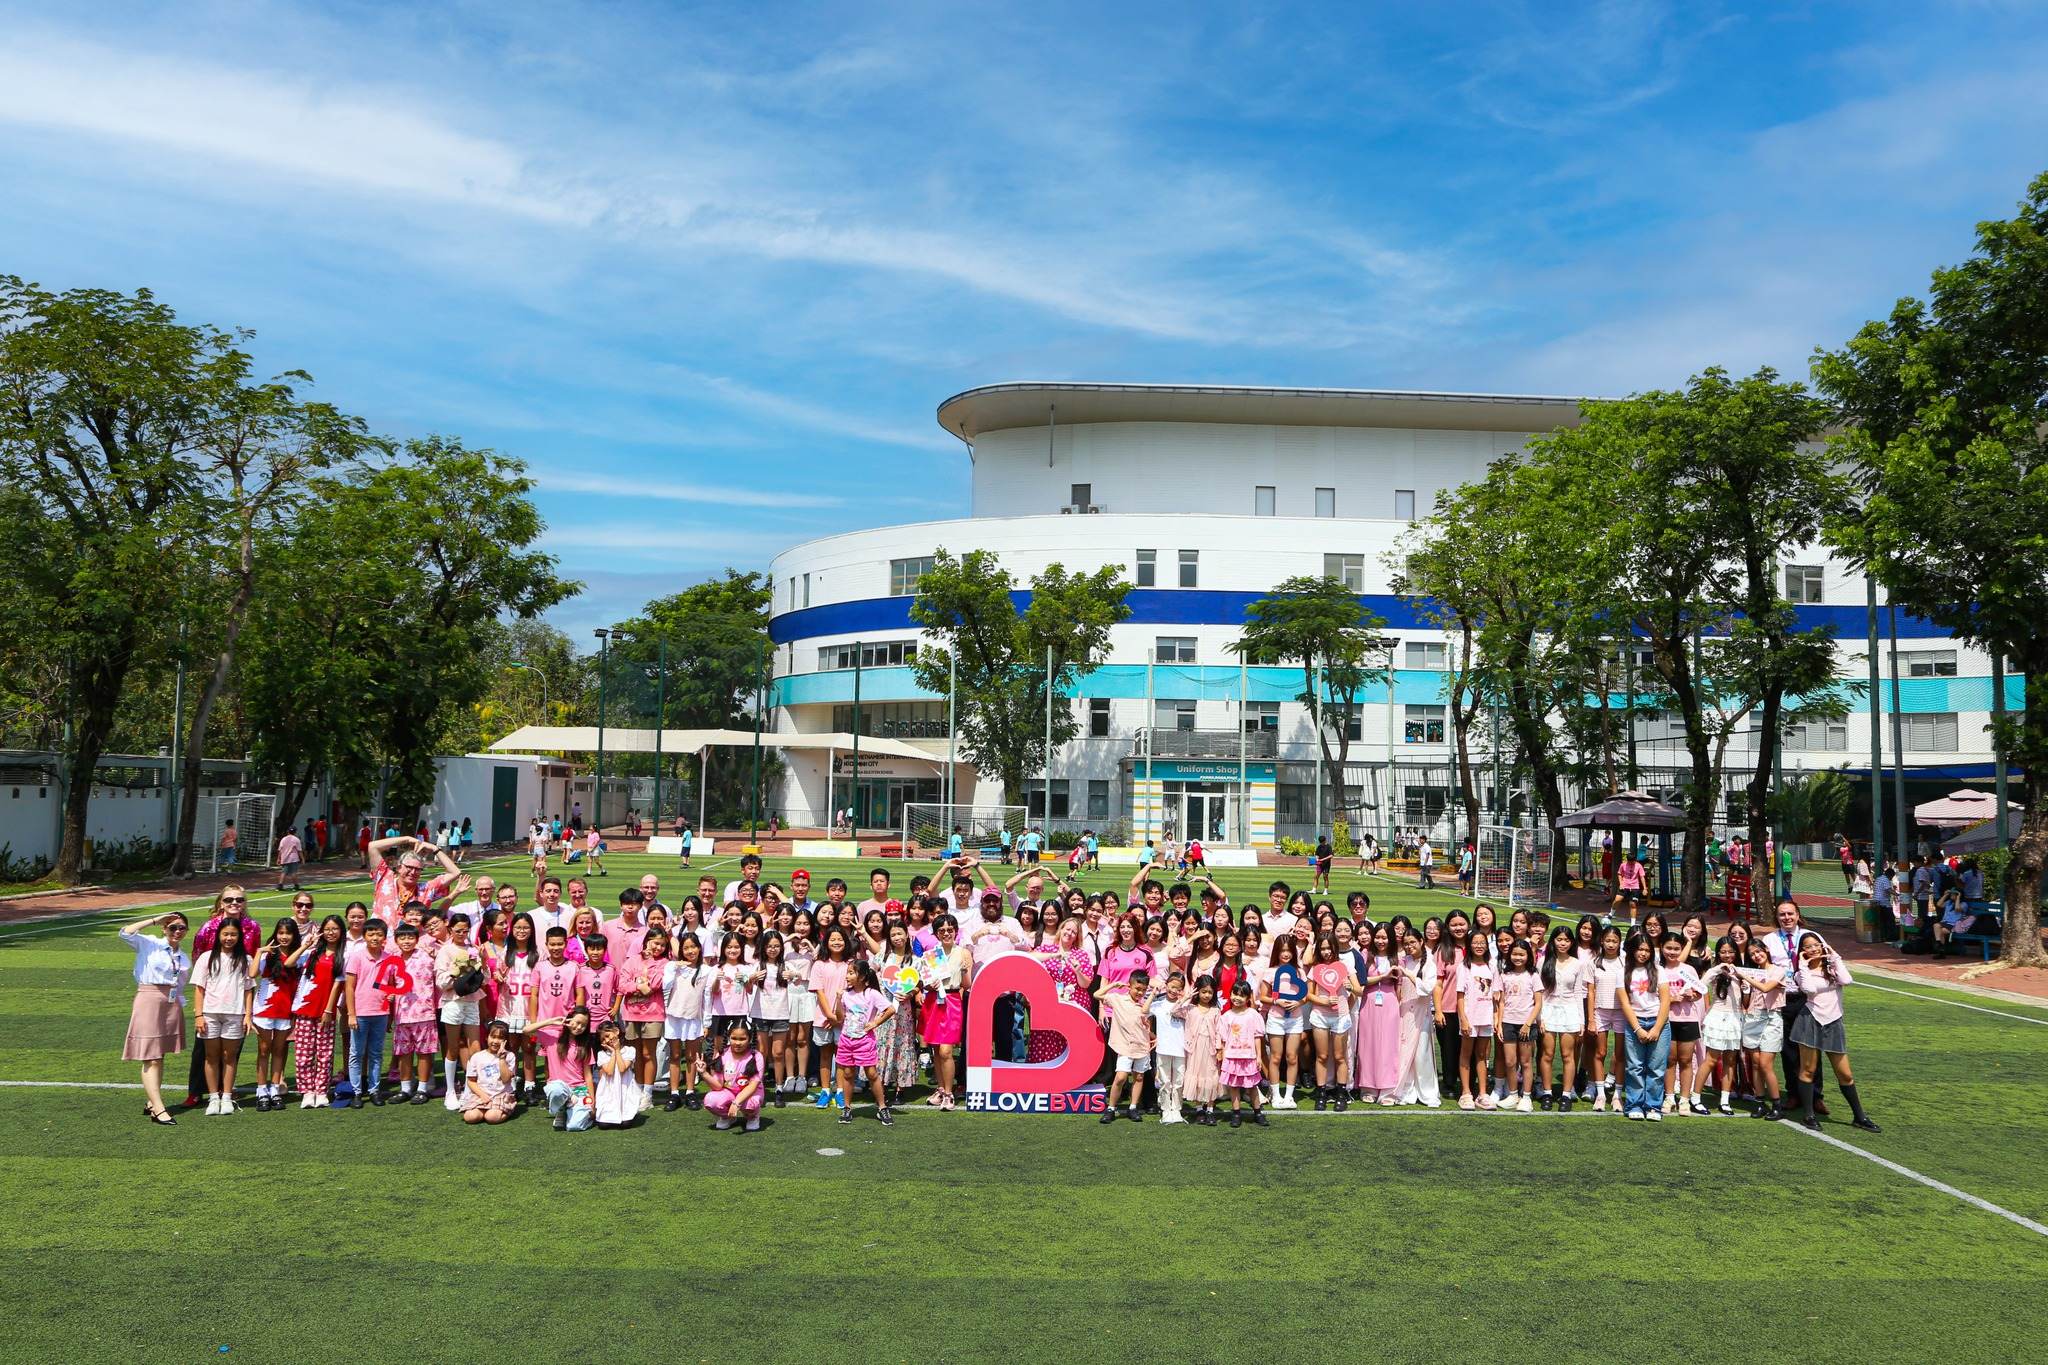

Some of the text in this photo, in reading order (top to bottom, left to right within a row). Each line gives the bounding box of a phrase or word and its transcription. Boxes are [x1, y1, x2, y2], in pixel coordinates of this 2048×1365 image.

[1176, 765, 1238, 774] Uniform Shop
[509, 973, 531, 996] 52
[967, 1092, 1106, 1112] #LOVEBVIS
